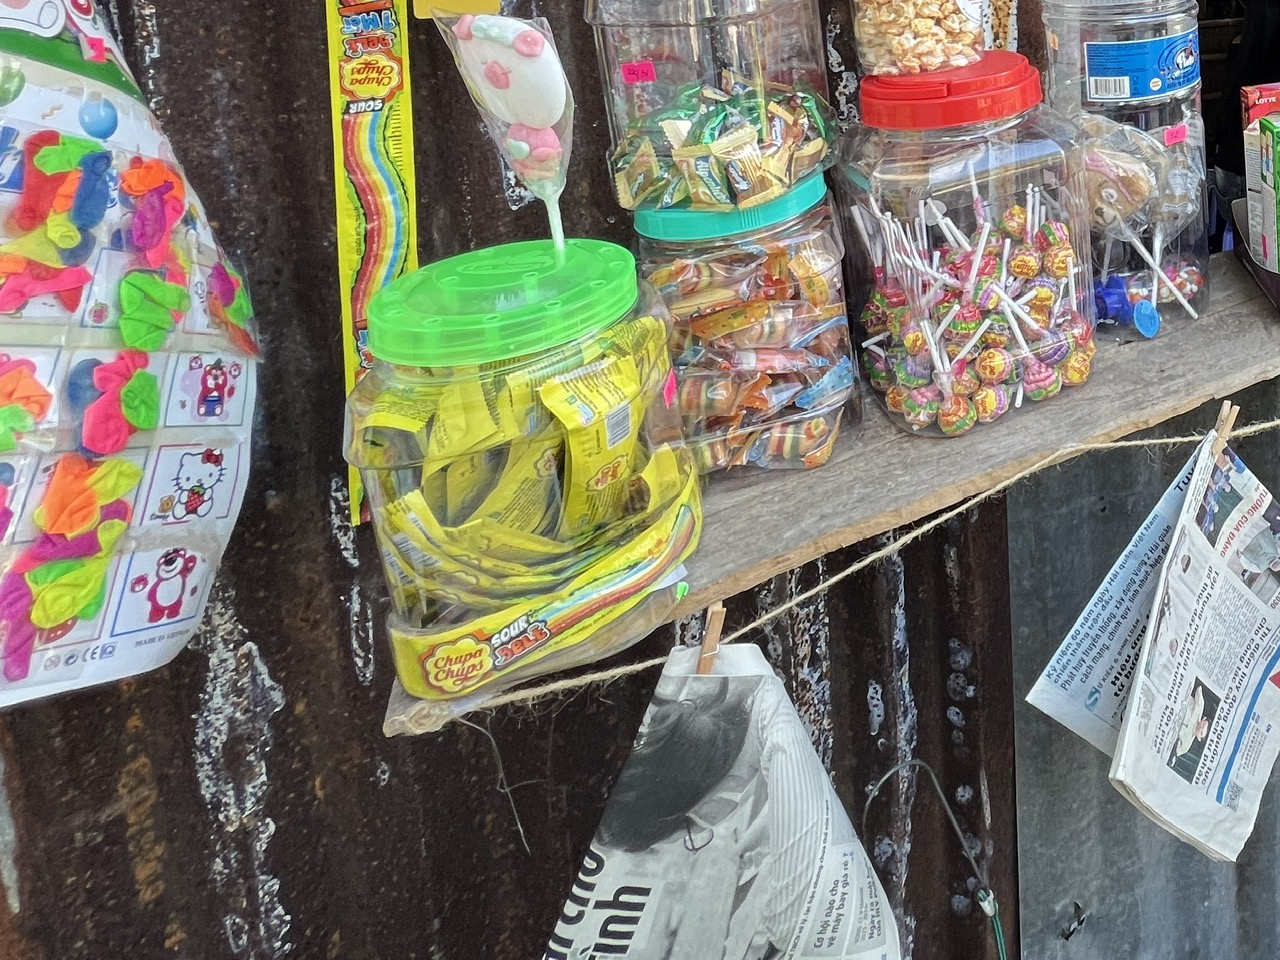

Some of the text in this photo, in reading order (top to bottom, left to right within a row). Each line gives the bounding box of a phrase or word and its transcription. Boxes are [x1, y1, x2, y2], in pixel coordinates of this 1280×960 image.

[350, 59, 393, 77] Chups
[349, 74, 391, 86] Chupa
[348, 98, 382, 113] SOUR
[1255, 96, 1276, 104] LOTTE
[1232, 512, 1250, 534] CỦA
[1069, 627, 1082, 642] 60
[1077, 607, 1096, 630] năm
[1091, 584, 1112, 610] ngày
[1116, 547, 1137, 572] quân
[1130, 530, 1147, 550] Việt
[1142, 511, 1160, 533] Nam
[1058, 669, 1078, 692] Phát
[1071, 655, 1089, 674] huy
[1080, 631, 1104, 658] truyền
[1111, 594, 1128, 611] xây
[1120, 575, 1139, 597] dựng
[1130, 557, 1149, 579] Vùng
[1143, 552, 1152, 560] 2
[1155, 522, 1174, 543] quân
[486, 614, 533, 648] SOUR
[1253, 616, 1268, 636] cho
[1258, 624, 1272, 642] Thí
[432, 645, 486, 675] Chupa
[1076, 661, 1096, 685] cách
[1103, 617, 1125, 642] chính
[1237, 636, 1256, 664] công
[432, 658, 487, 690] Chups
[1228, 665, 1244, 685] tác
[1231, 670, 1249, 692] huy
[1207, 705, 1229, 735] cách
[839, 871, 851, 889] giá
[835, 890, 848, 911] bay
[592, 886, 651, 960] ình
[812, 877, 840, 949] Cơ hội nào cho
[830, 912, 844, 934] máy
[863, 900, 880, 940] Ngày ra
[825, 933, 837, 949] vé
